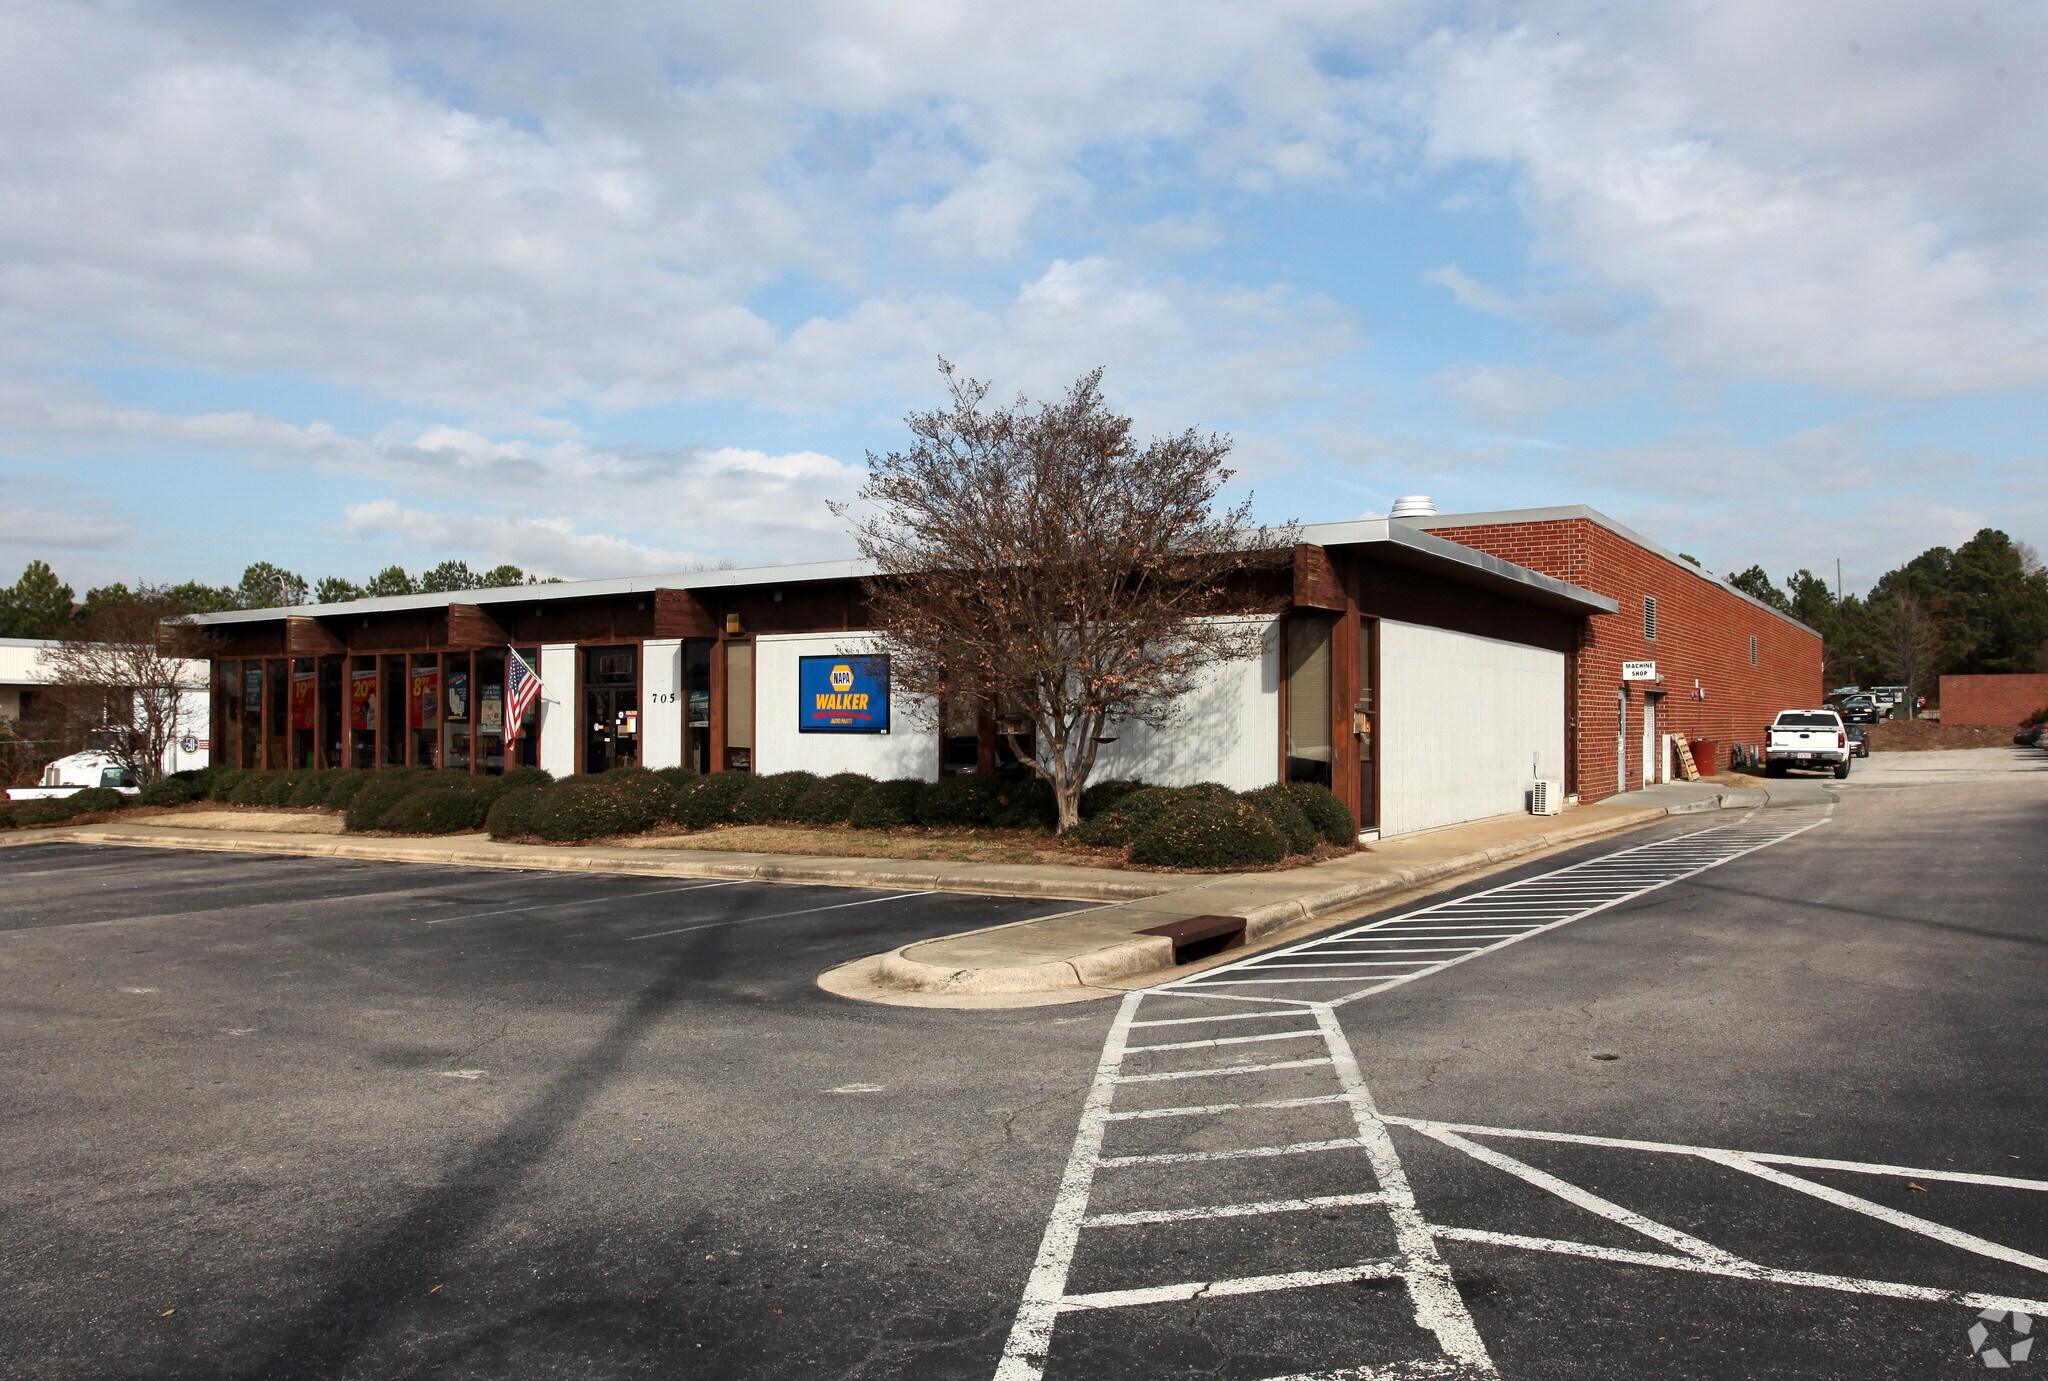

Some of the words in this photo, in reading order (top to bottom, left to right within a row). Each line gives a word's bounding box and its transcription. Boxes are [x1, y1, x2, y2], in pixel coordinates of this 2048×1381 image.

[833, 672, 850, 684] NAPA
[652, 693, 675, 704] 705
[816, 693, 869, 710] WALKER
